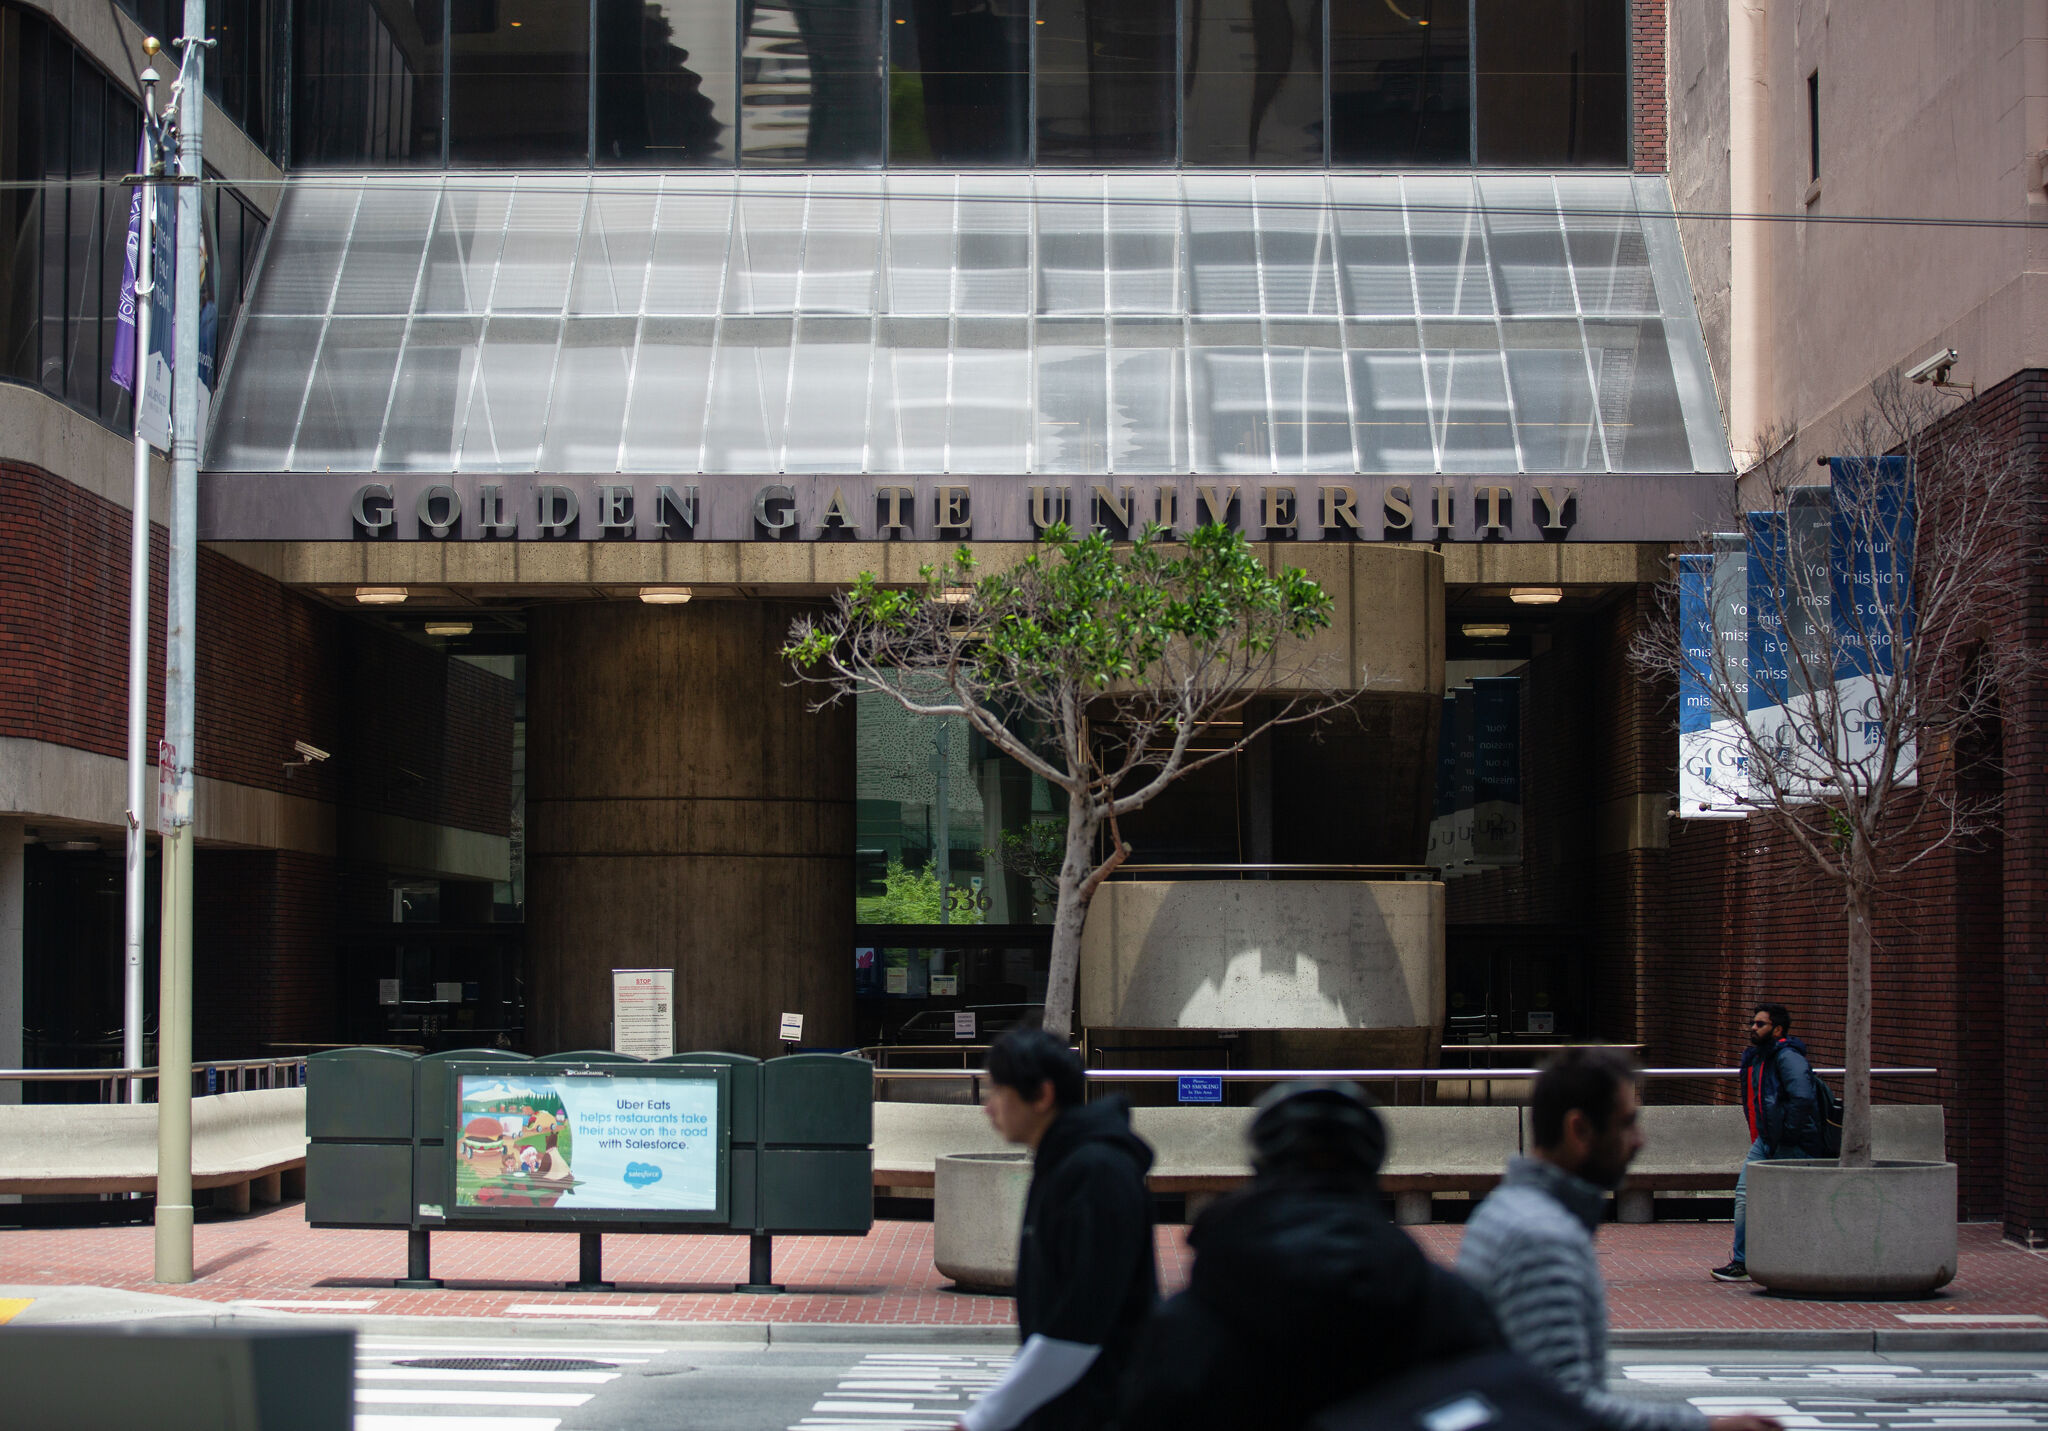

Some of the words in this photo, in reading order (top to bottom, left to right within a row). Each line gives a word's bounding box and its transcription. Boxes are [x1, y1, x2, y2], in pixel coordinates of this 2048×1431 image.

[351, 484, 697, 528] GOLDEN
[753, 484, 971, 528] GATE
[1027, 485, 1581, 529] UNIVERSITY
[1854, 540, 1891, 553] Your
[1764, 640, 1776, 653] is
[1727, 655, 1738, 667] is
[943, 886, 993, 911] 536
[617, 1099, 643, 1110] Uber
[648, 1100, 671, 1110] Eats
[580, 1112, 611, 1124] helps
[616, 1113, 678, 1124] restaurants
[681, 1113, 708, 1124] take
[579, 1125, 604, 1136] their
[607, 1126, 638, 1136] show
[640, 1128, 654, 1136] on
[659, 1126, 677, 1137] the
[681, 1127, 708, 1137] road
[599, 1139, 622, 1149] with
[625, 1139, 689, 1150] Salesforce.
[628, 1170, 659, 1179] salesforce
